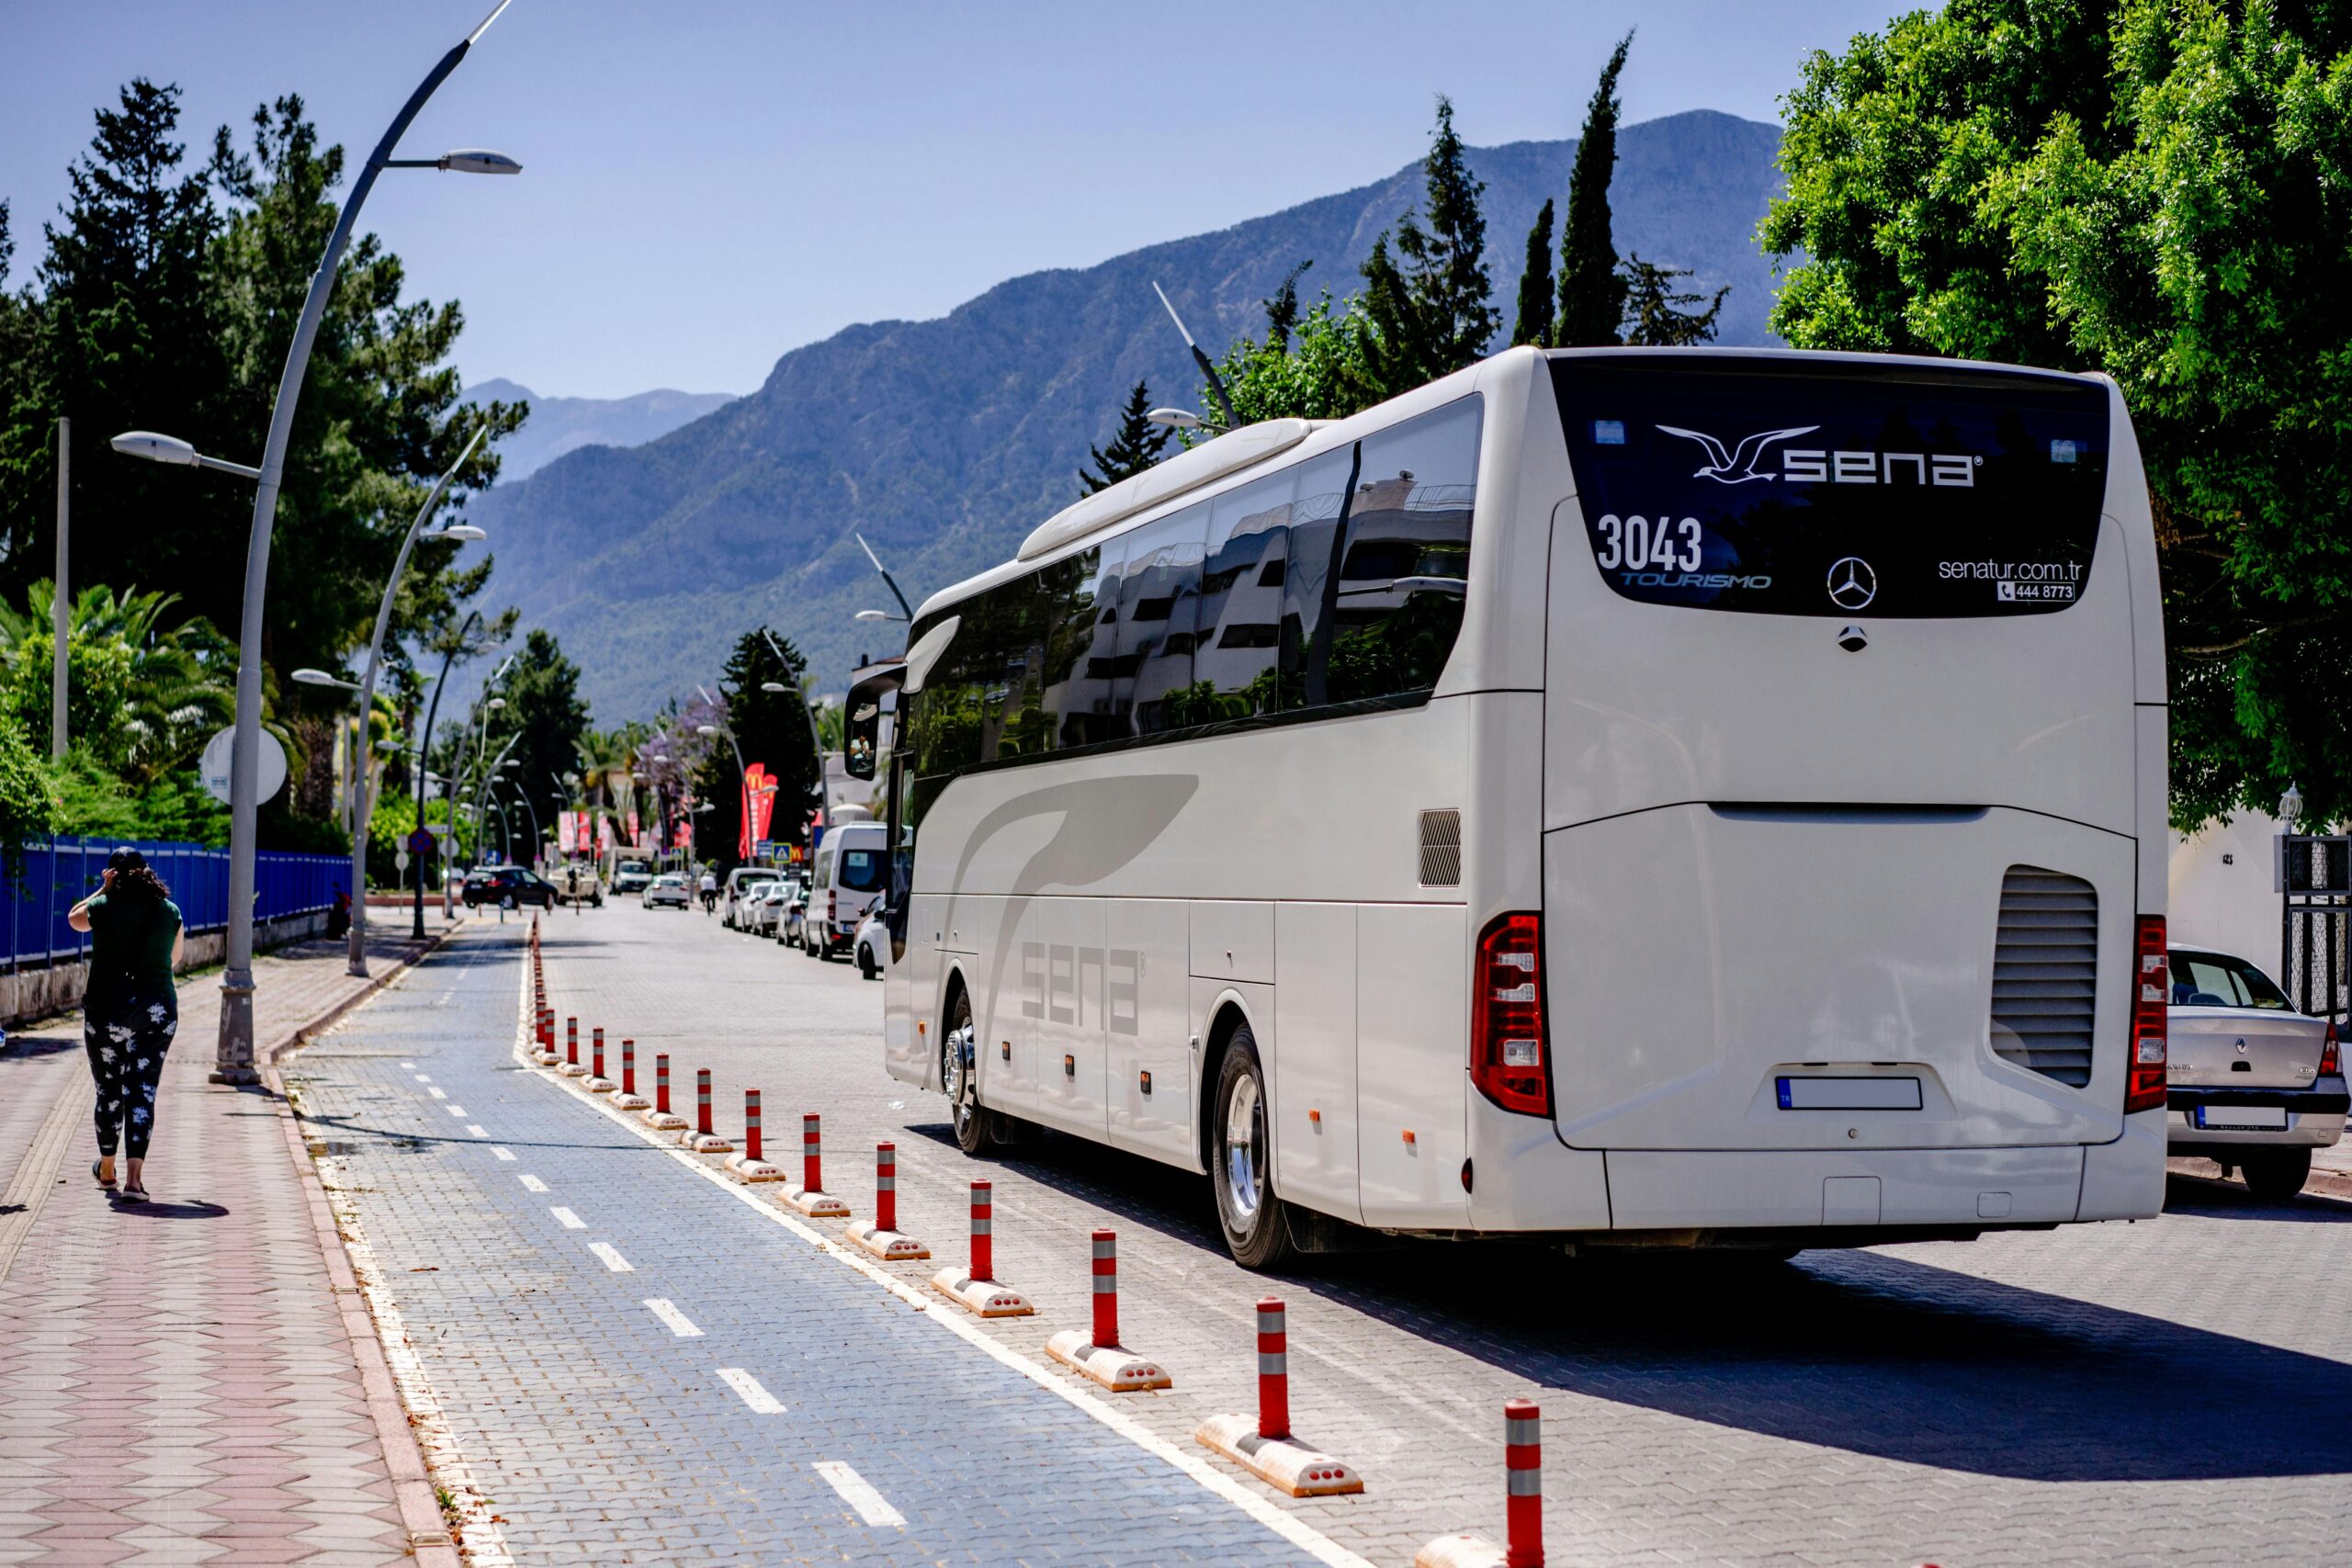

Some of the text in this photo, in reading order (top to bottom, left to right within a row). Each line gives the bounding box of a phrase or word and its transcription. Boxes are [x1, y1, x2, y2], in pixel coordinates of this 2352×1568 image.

[1598, 513, 1702, 572] 3043
[1939, 558, 2083, 581] senatur.com.tr
[1620, 572, 1772, 589] TOURISMO
[2016, 585, 2073, 598] 444 8773
